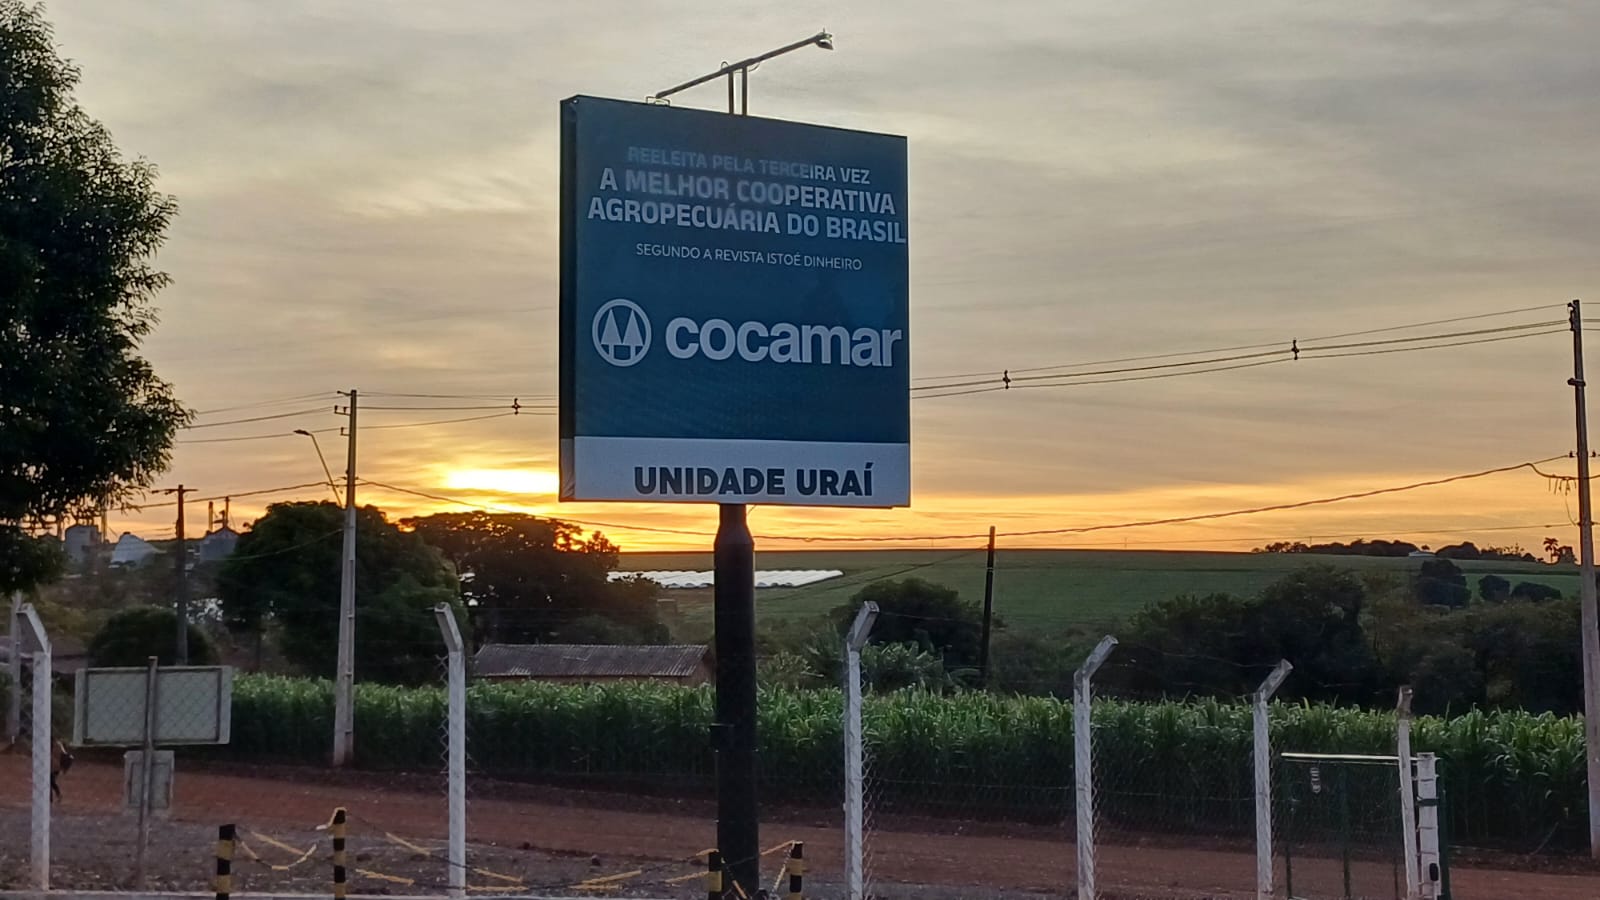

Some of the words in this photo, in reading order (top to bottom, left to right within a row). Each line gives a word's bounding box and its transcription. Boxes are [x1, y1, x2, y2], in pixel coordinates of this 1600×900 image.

[627, 146, 707, 169] REELEITA
[712, 154, 754, 174] PELA
[759, 159, 836, 182] TERCEIRA
[840, 167, 871, 185] VEZ
[599, 167, 618, 191] A
[625, 169, 729, 200] MELHOR
[736, 180, 896, 215] COOPERATIVA
[587, 196, 780, 234] AGROPECUÁRIA
[787, 212, 819, 237] DO
[826, 216, 907, 244] BRASIL
[636, 243, 700, 259] SEGUNDO
[703, 248, 713, 260] A
[715, 248, 764, 264] REVISTA
[767, 252, 801, 266] ISTOÉ
[804, 255, 863, 271] DINHEIRO
[665, 317, 902, 367] cocamar
[634, 466, 785, 495] UNIDADE
[796, 462, 874, 496] URAÍ
